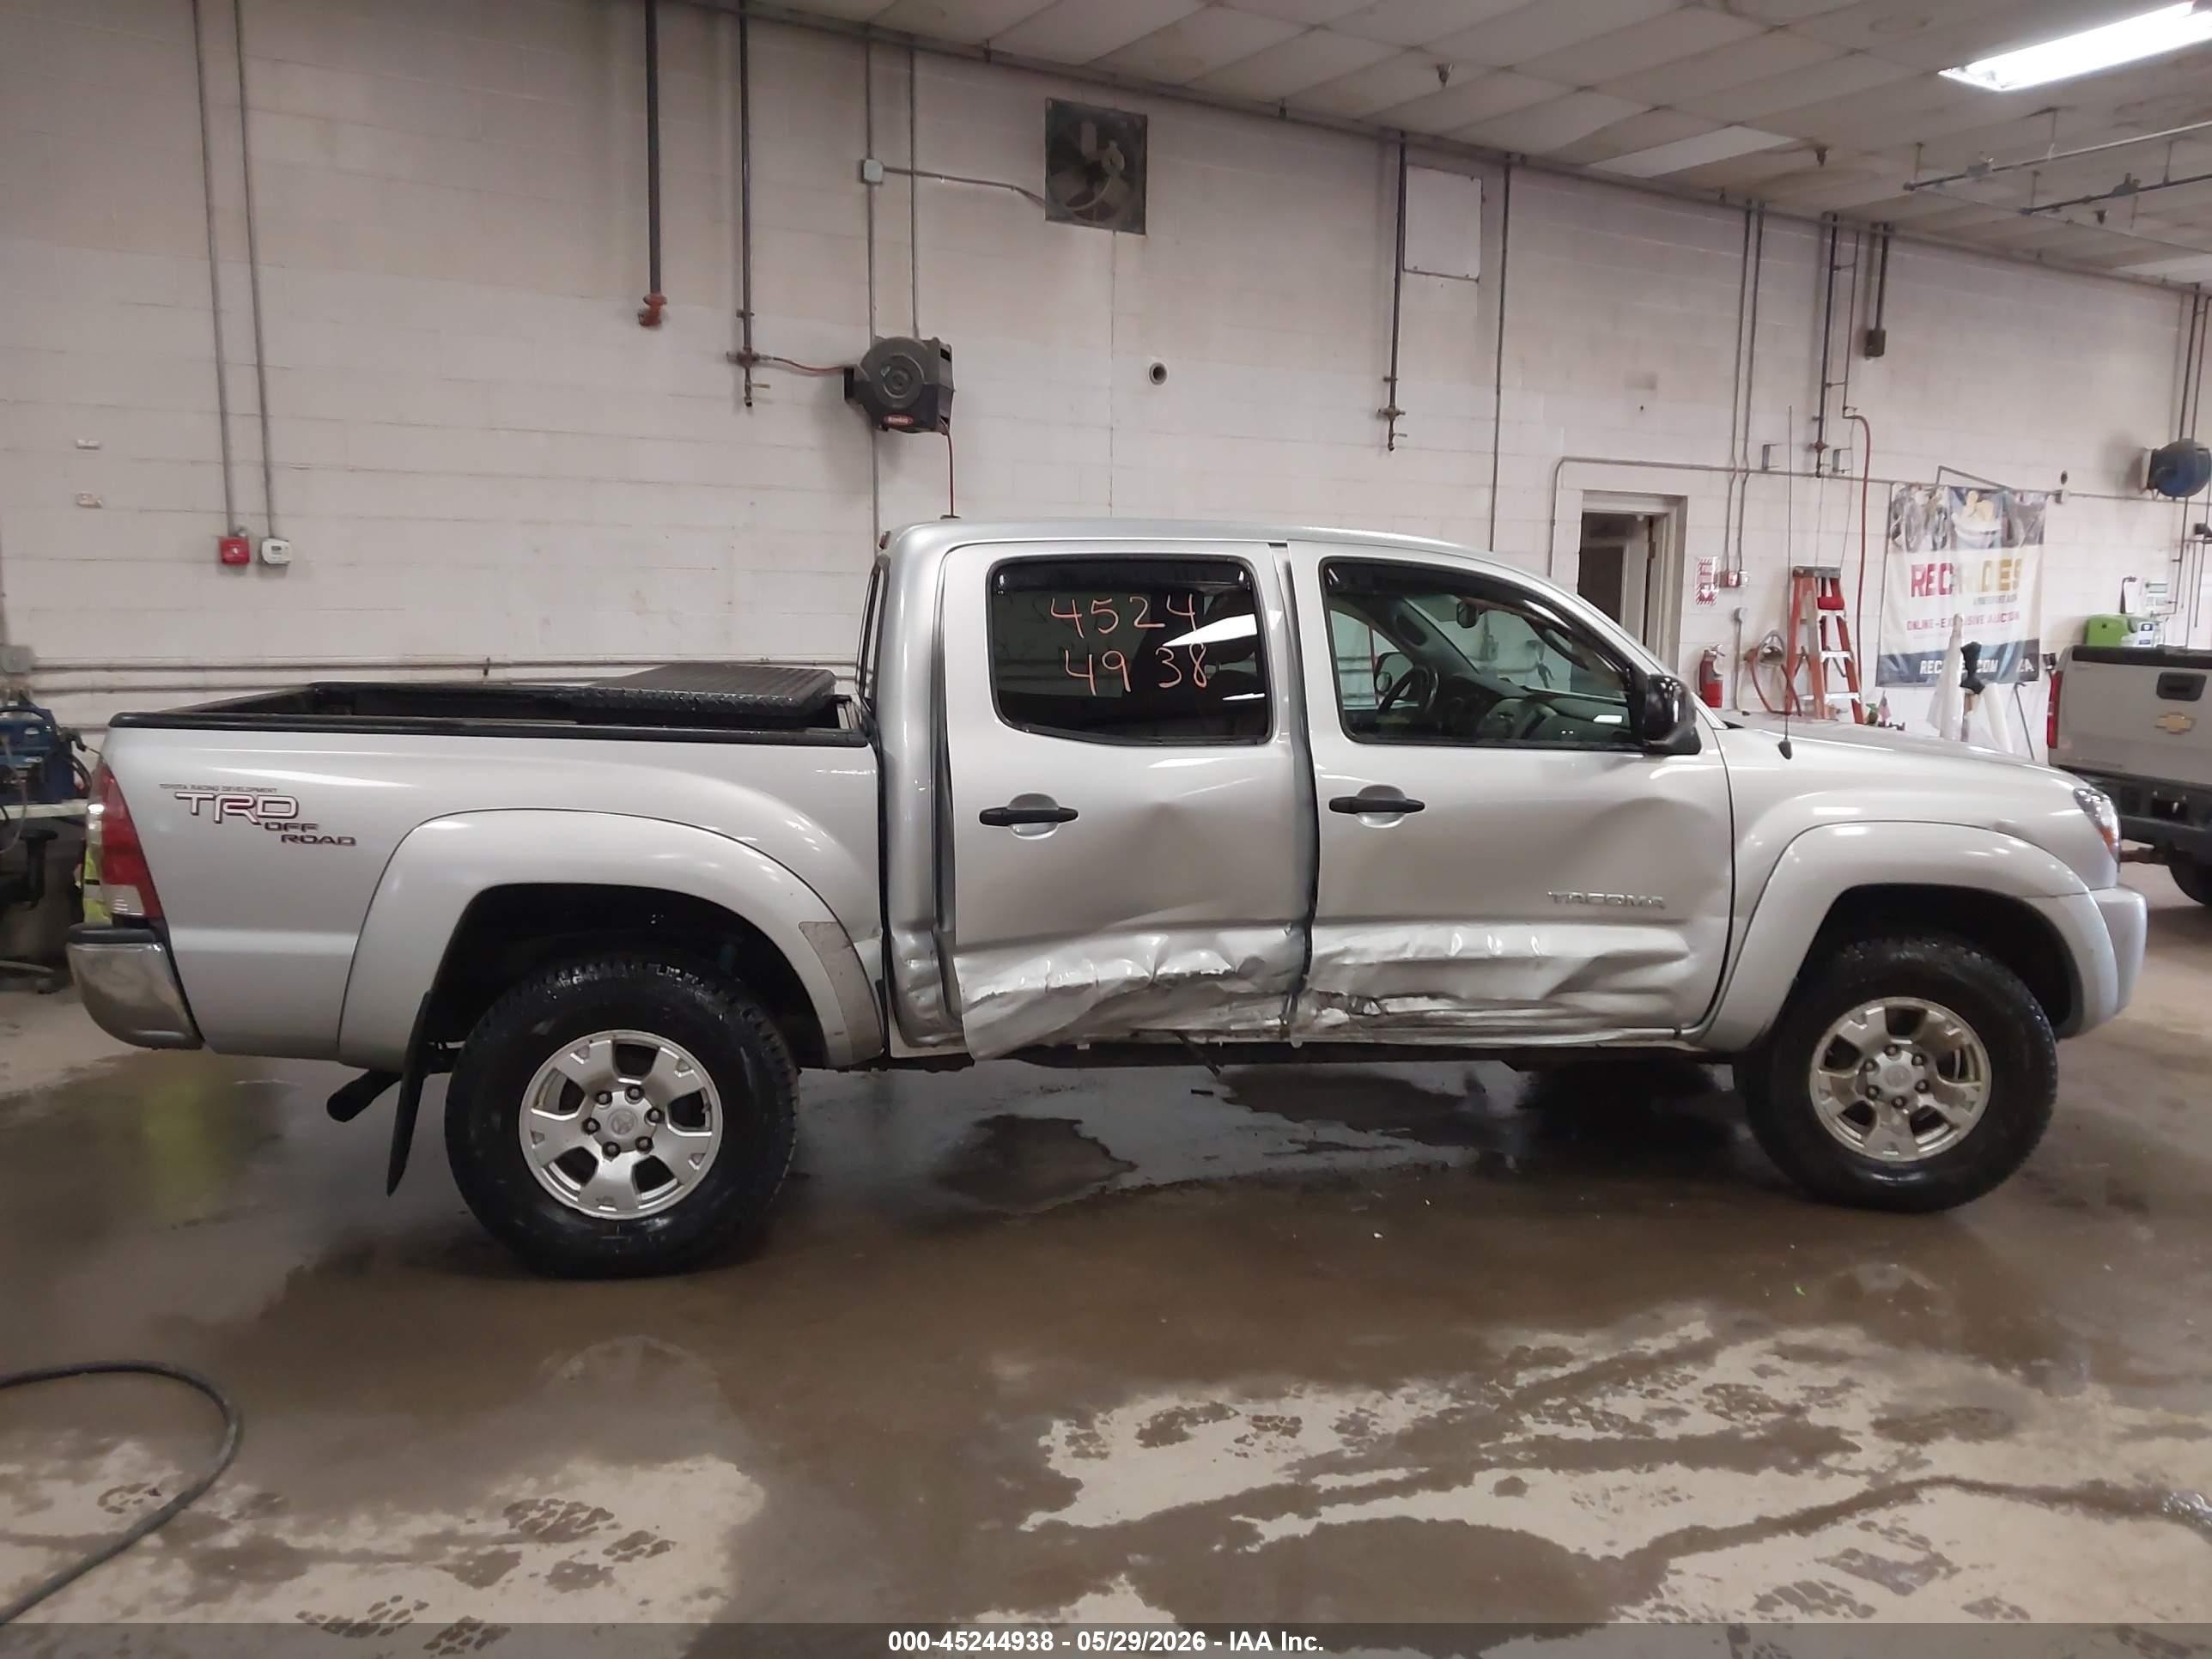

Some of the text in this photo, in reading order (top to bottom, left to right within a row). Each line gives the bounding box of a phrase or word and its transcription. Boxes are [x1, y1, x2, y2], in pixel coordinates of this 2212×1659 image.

[1049, 592, 1197, 639] 4524
[174, 791, 299, 825] TRD
[264, 821, 319, 833] OFF
[281, 833, 356, 847] ROAD
[1547, 890, 1666, 908] TACOMA
